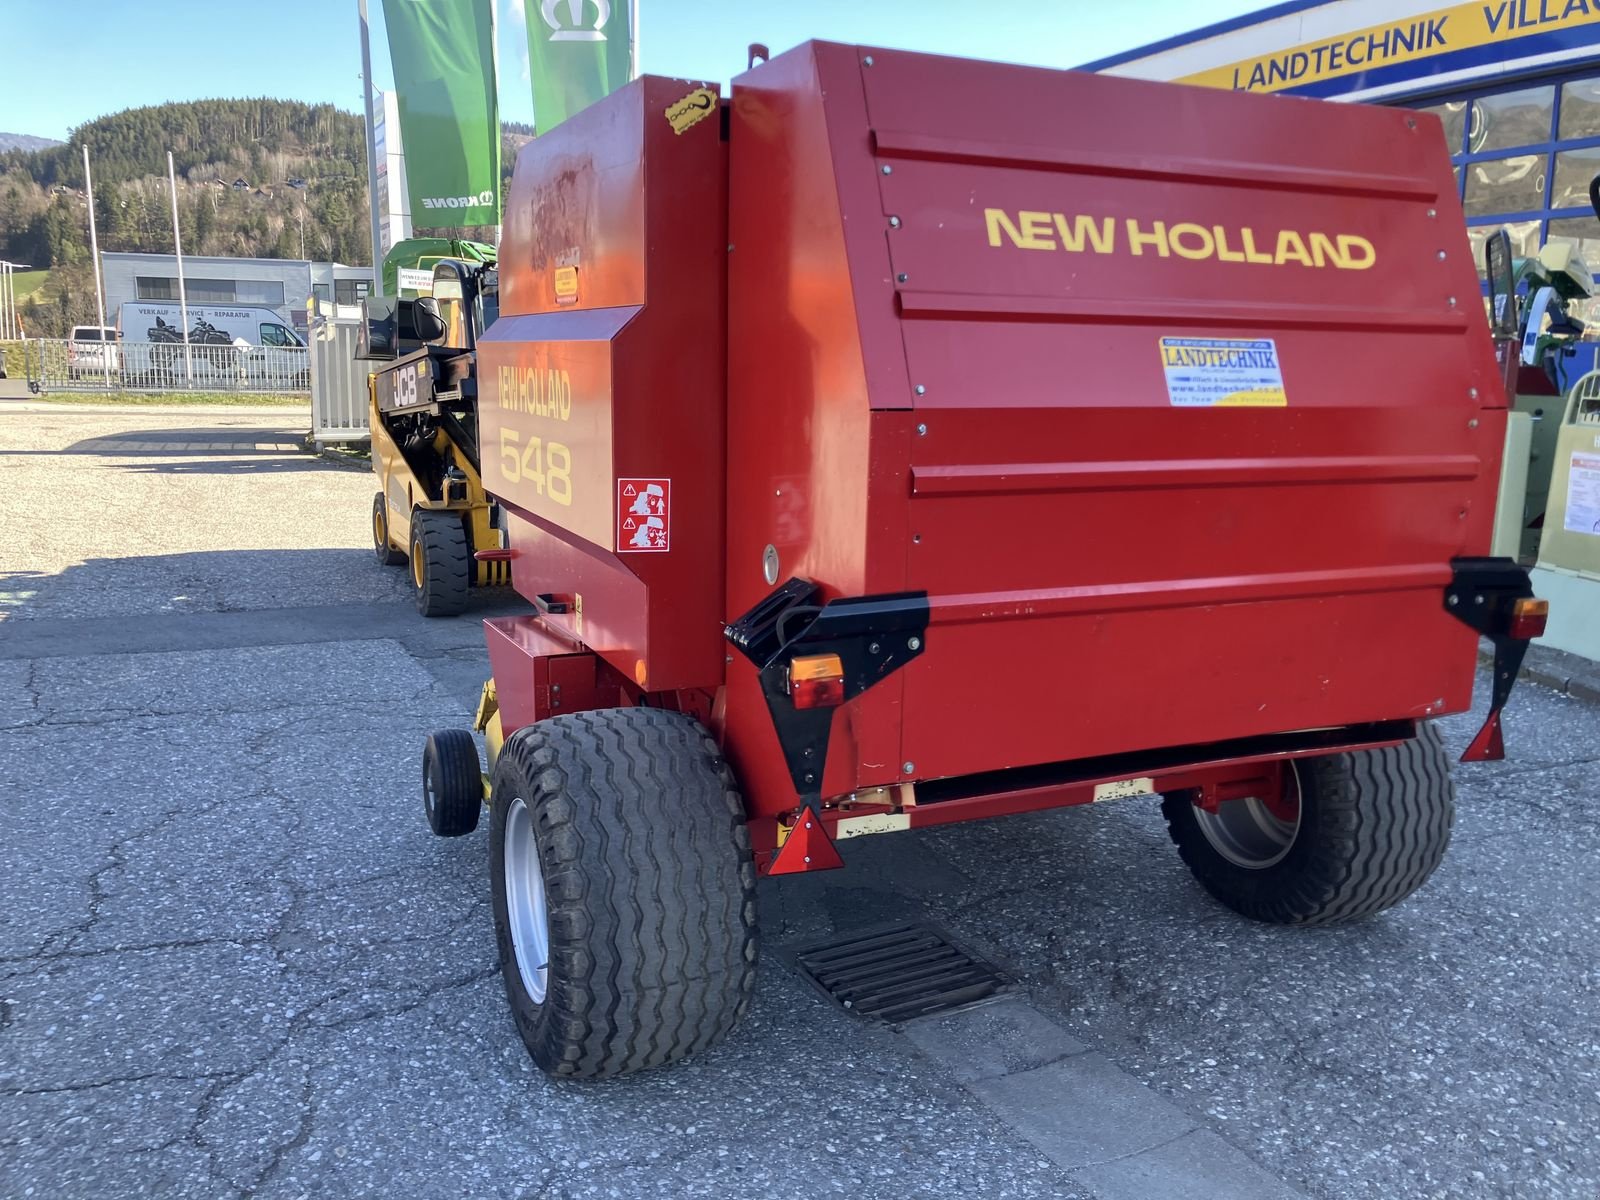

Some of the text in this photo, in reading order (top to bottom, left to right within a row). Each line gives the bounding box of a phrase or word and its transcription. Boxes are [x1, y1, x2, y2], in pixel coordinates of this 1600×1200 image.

[1232, 15, 1449, 92] LANDTECHNIK
[984, 207, 1377, 270] NEW HOLLAND
[138, 308, 169, 316] VERKAUF
[214, 311, 250, 319] REPARATUR
[393, 366, 417, 408] JCB
[1164, 348, 1277, 369] LANDTECHNIK
[498, 365, 571, 422] NEW HOLLAND
[500, 427, 572, 507] 548
